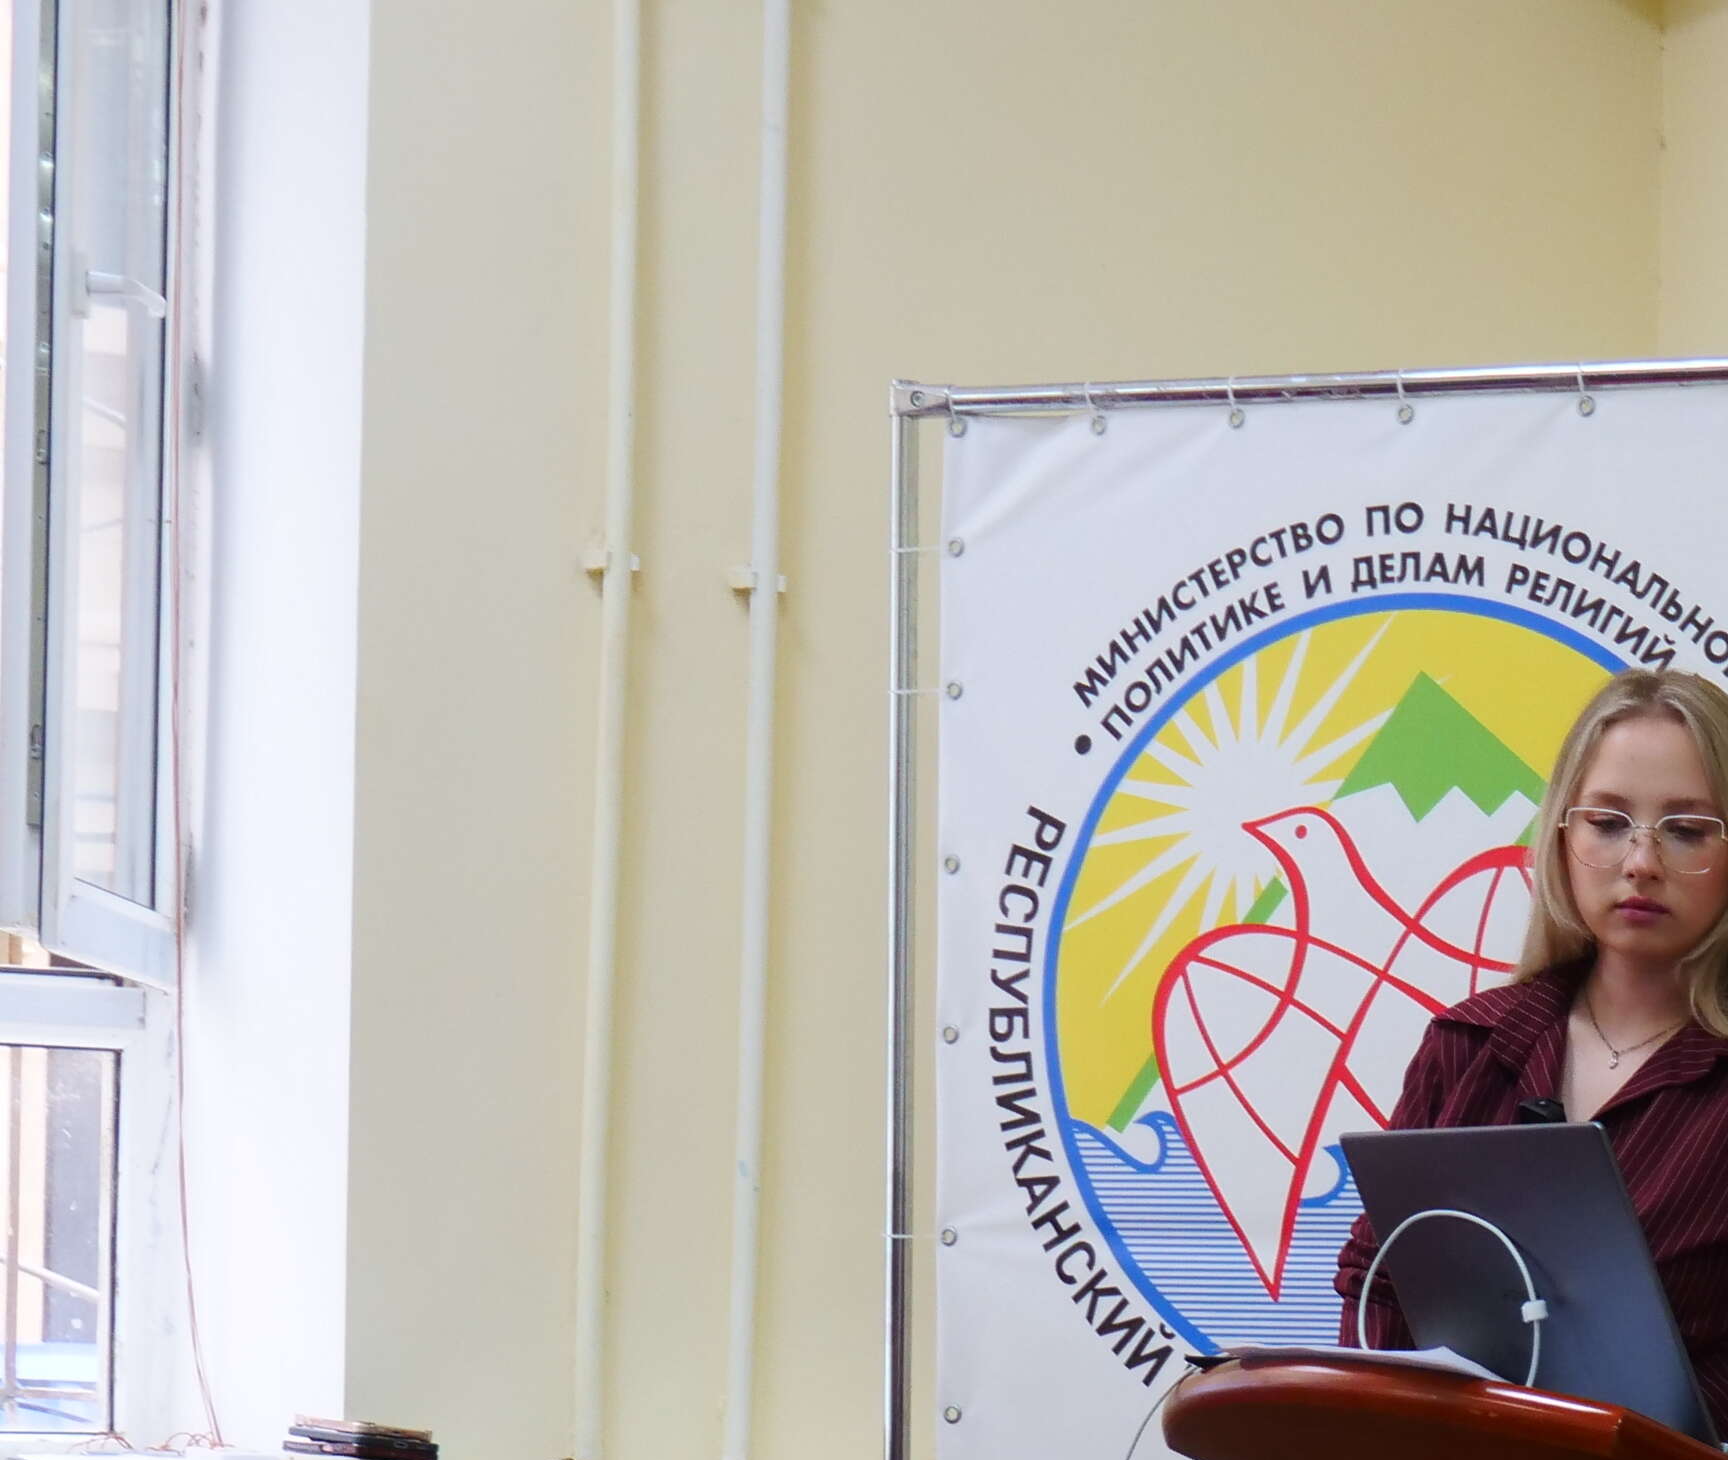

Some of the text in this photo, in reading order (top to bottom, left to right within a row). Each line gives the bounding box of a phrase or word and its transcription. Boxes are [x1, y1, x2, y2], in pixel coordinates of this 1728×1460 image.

[1072, 512, 1345, 709] МИНИСТЕРСТВО
[1365, 502, 1425, 538] ПО
[1100, 551, 1678, 742] ПОЛИТИКЕ И ДЕЛАМ РЕЛИГИЙ
[988, 805, 1176, 1388] РЕСПУБЛИКАНСКИЙ
